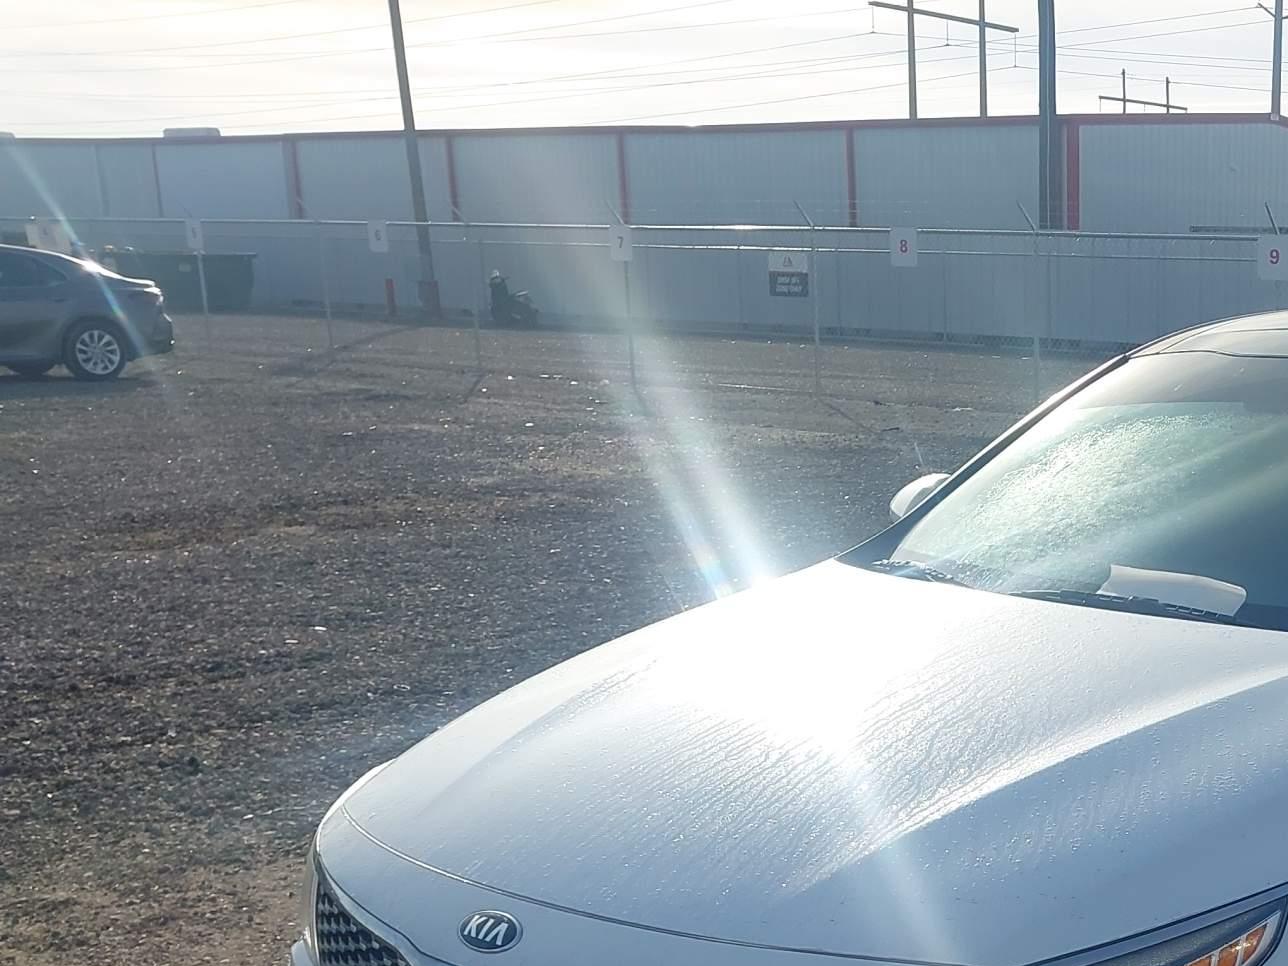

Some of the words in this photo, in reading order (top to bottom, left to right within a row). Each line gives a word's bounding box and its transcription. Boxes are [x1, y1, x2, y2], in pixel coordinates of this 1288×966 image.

[617, 236, 624, 248] 7
[900, 239, 908, 253] 8
[1270, 248, 1280, 265] 9
[463, 914, 509, 946] KIA
